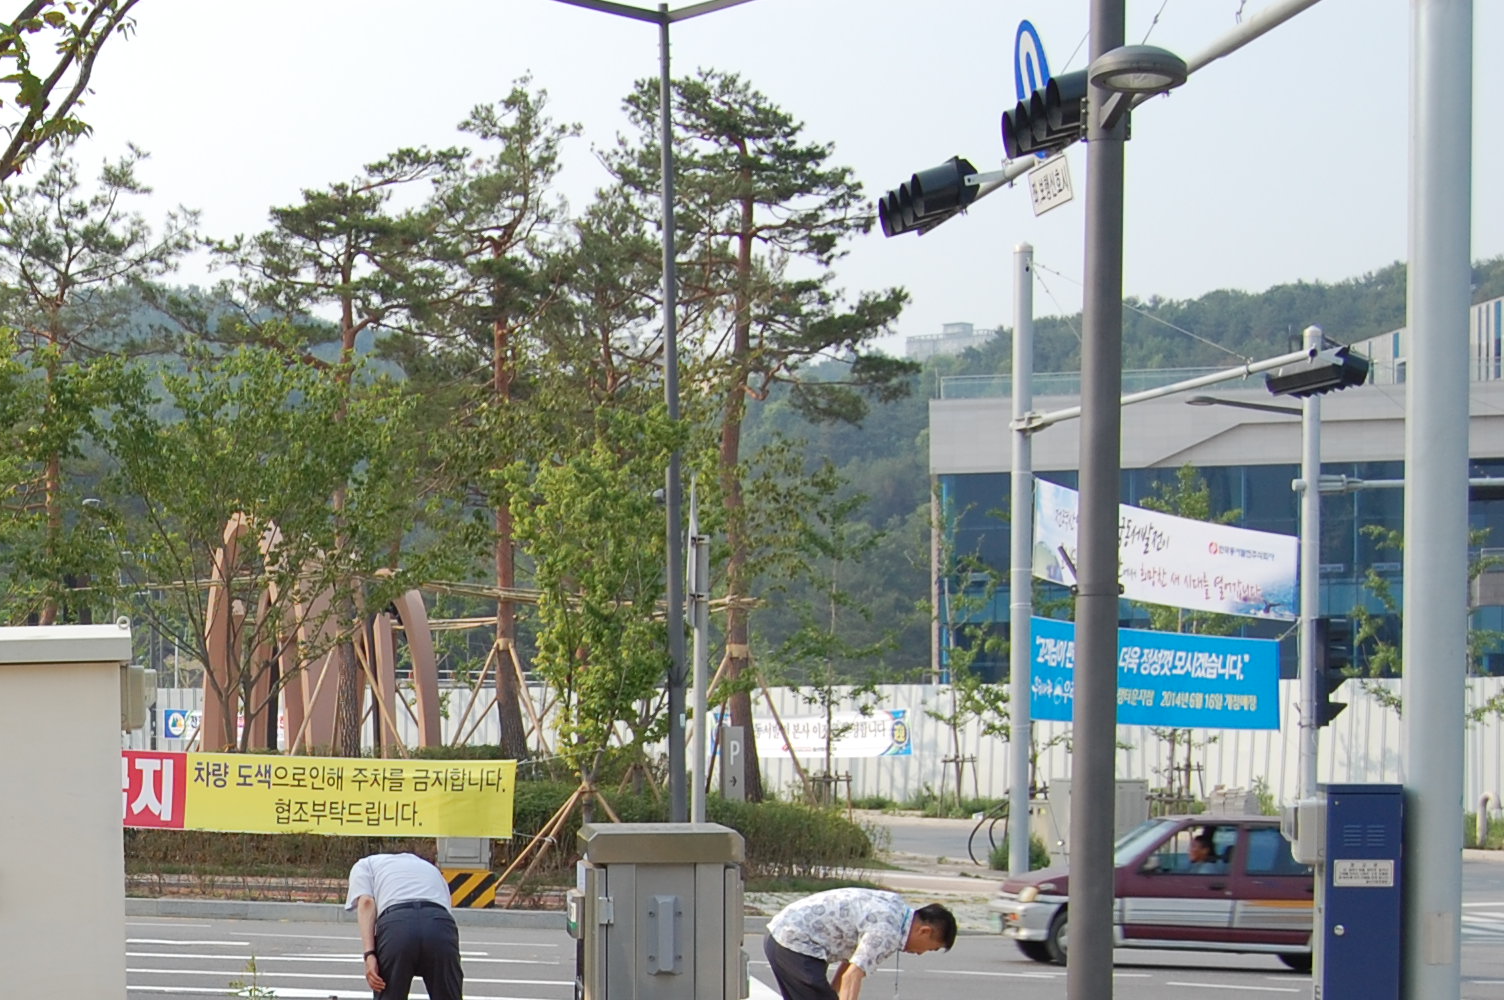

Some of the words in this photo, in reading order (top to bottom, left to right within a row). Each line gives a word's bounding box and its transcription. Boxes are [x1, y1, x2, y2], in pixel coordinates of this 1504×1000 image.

[730, 740, 740, 766] P
[122, 757, 174, 821] 지
[194, 761, 230, 788] 차량
[236, 763, 344, 792] 도색으로인해
[351, 766, 406, 792] 주차를
[412, 767, 506, 793] 금지합니다.
[274, 798, 423, 828] 협조부탁드립니다.
